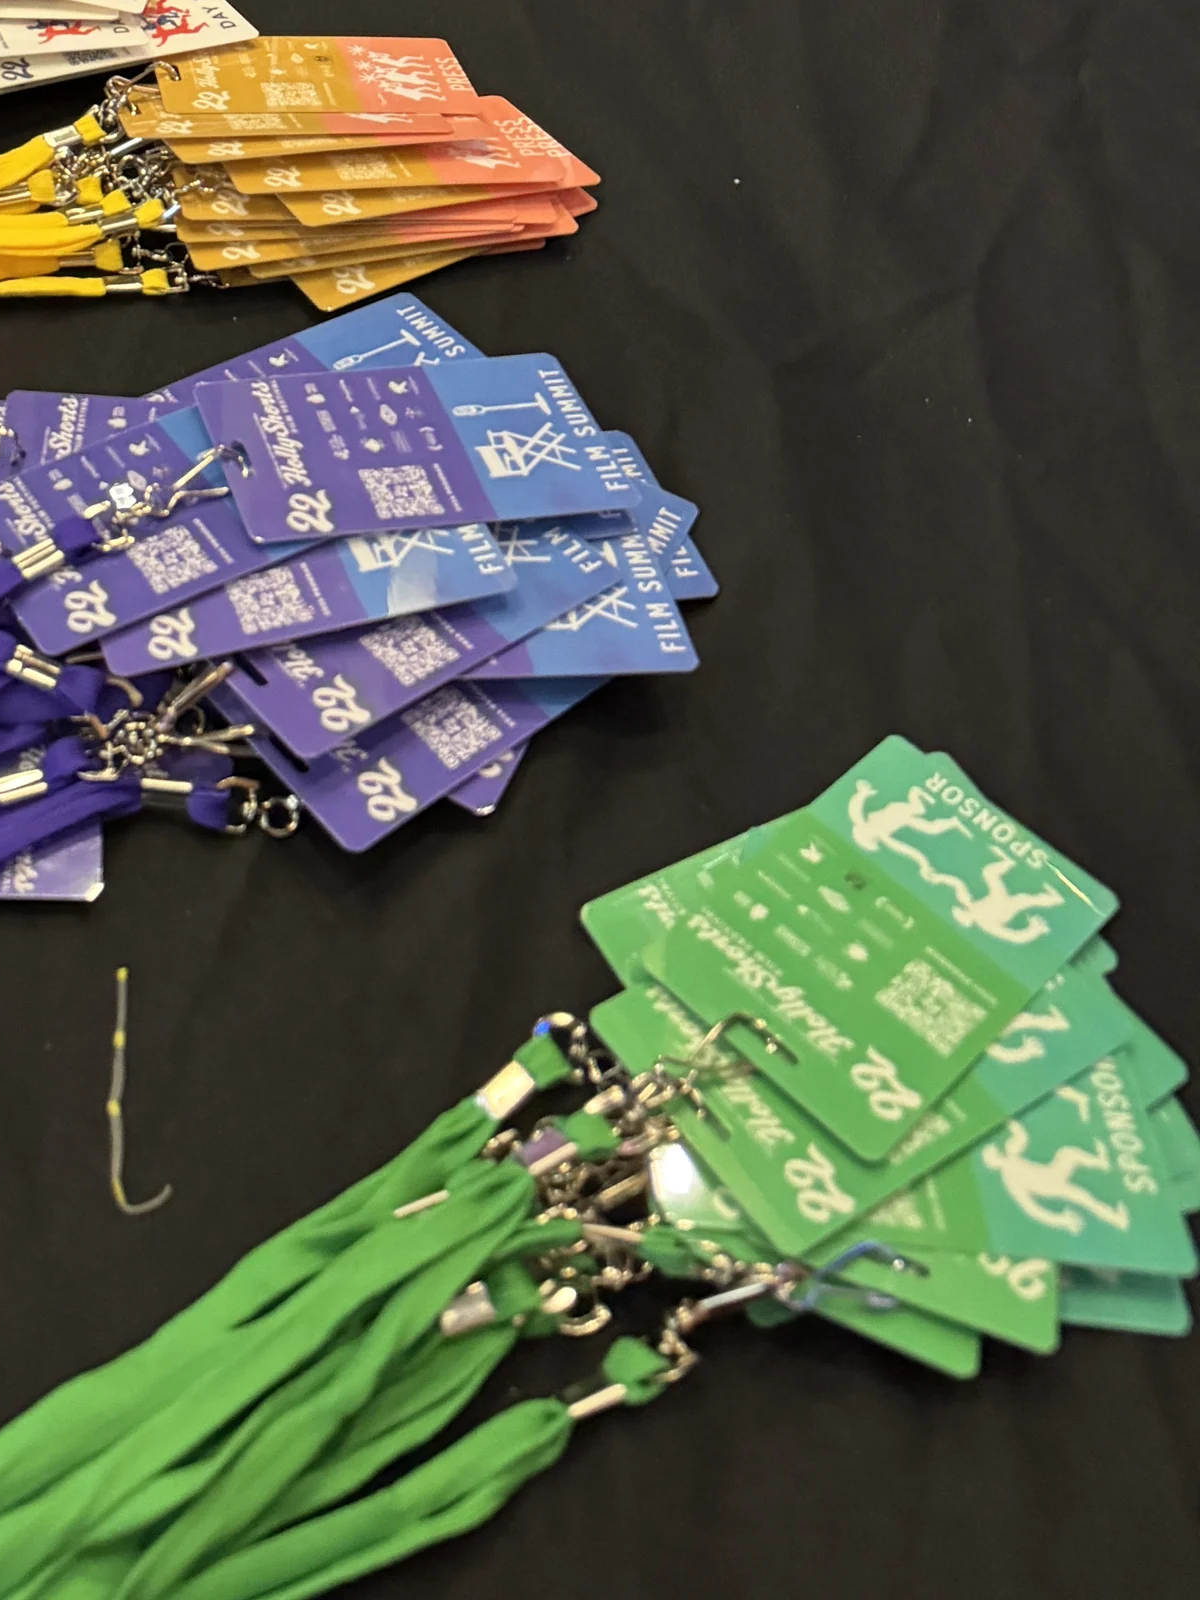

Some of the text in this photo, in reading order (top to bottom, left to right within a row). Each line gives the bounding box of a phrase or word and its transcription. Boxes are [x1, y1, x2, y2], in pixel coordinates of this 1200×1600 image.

[202, 5, 236, 29] DAY
[1, 58, 34, 81] 22
[191, 90, 231, 111] 22
[493, 119, 545, 156] PRESS
[263, 165, 303, 188] 22
[321, 192, 362, 216] 22
[396, 305, 466, 358] SUMMIT
[49, 397, 79, 460] Shorts
[251, 381, 334, 533] 22 HollyShorts
[537, 369, 630, 492] FILM SUMMIT
[457, 523, 505, 576] FILM
[542, 526, 603, 575] FILM
[64, 580, 117, 634] 22
[621, 534, 687, 654] FILM SUMM
[148, 608, 198, 660] 22
[312, 673, 372, 733] 22
[357, 757, 418, 822] 22
[924, 771, 1050, 870] SPONSOR
[687, 913, 855, 1059] HollyShorts
[850, 1044, 924, 1121] 22
[1089, 1057, 1159, 1194] SPONSO
[784, 1142, 856, 1224] 22
